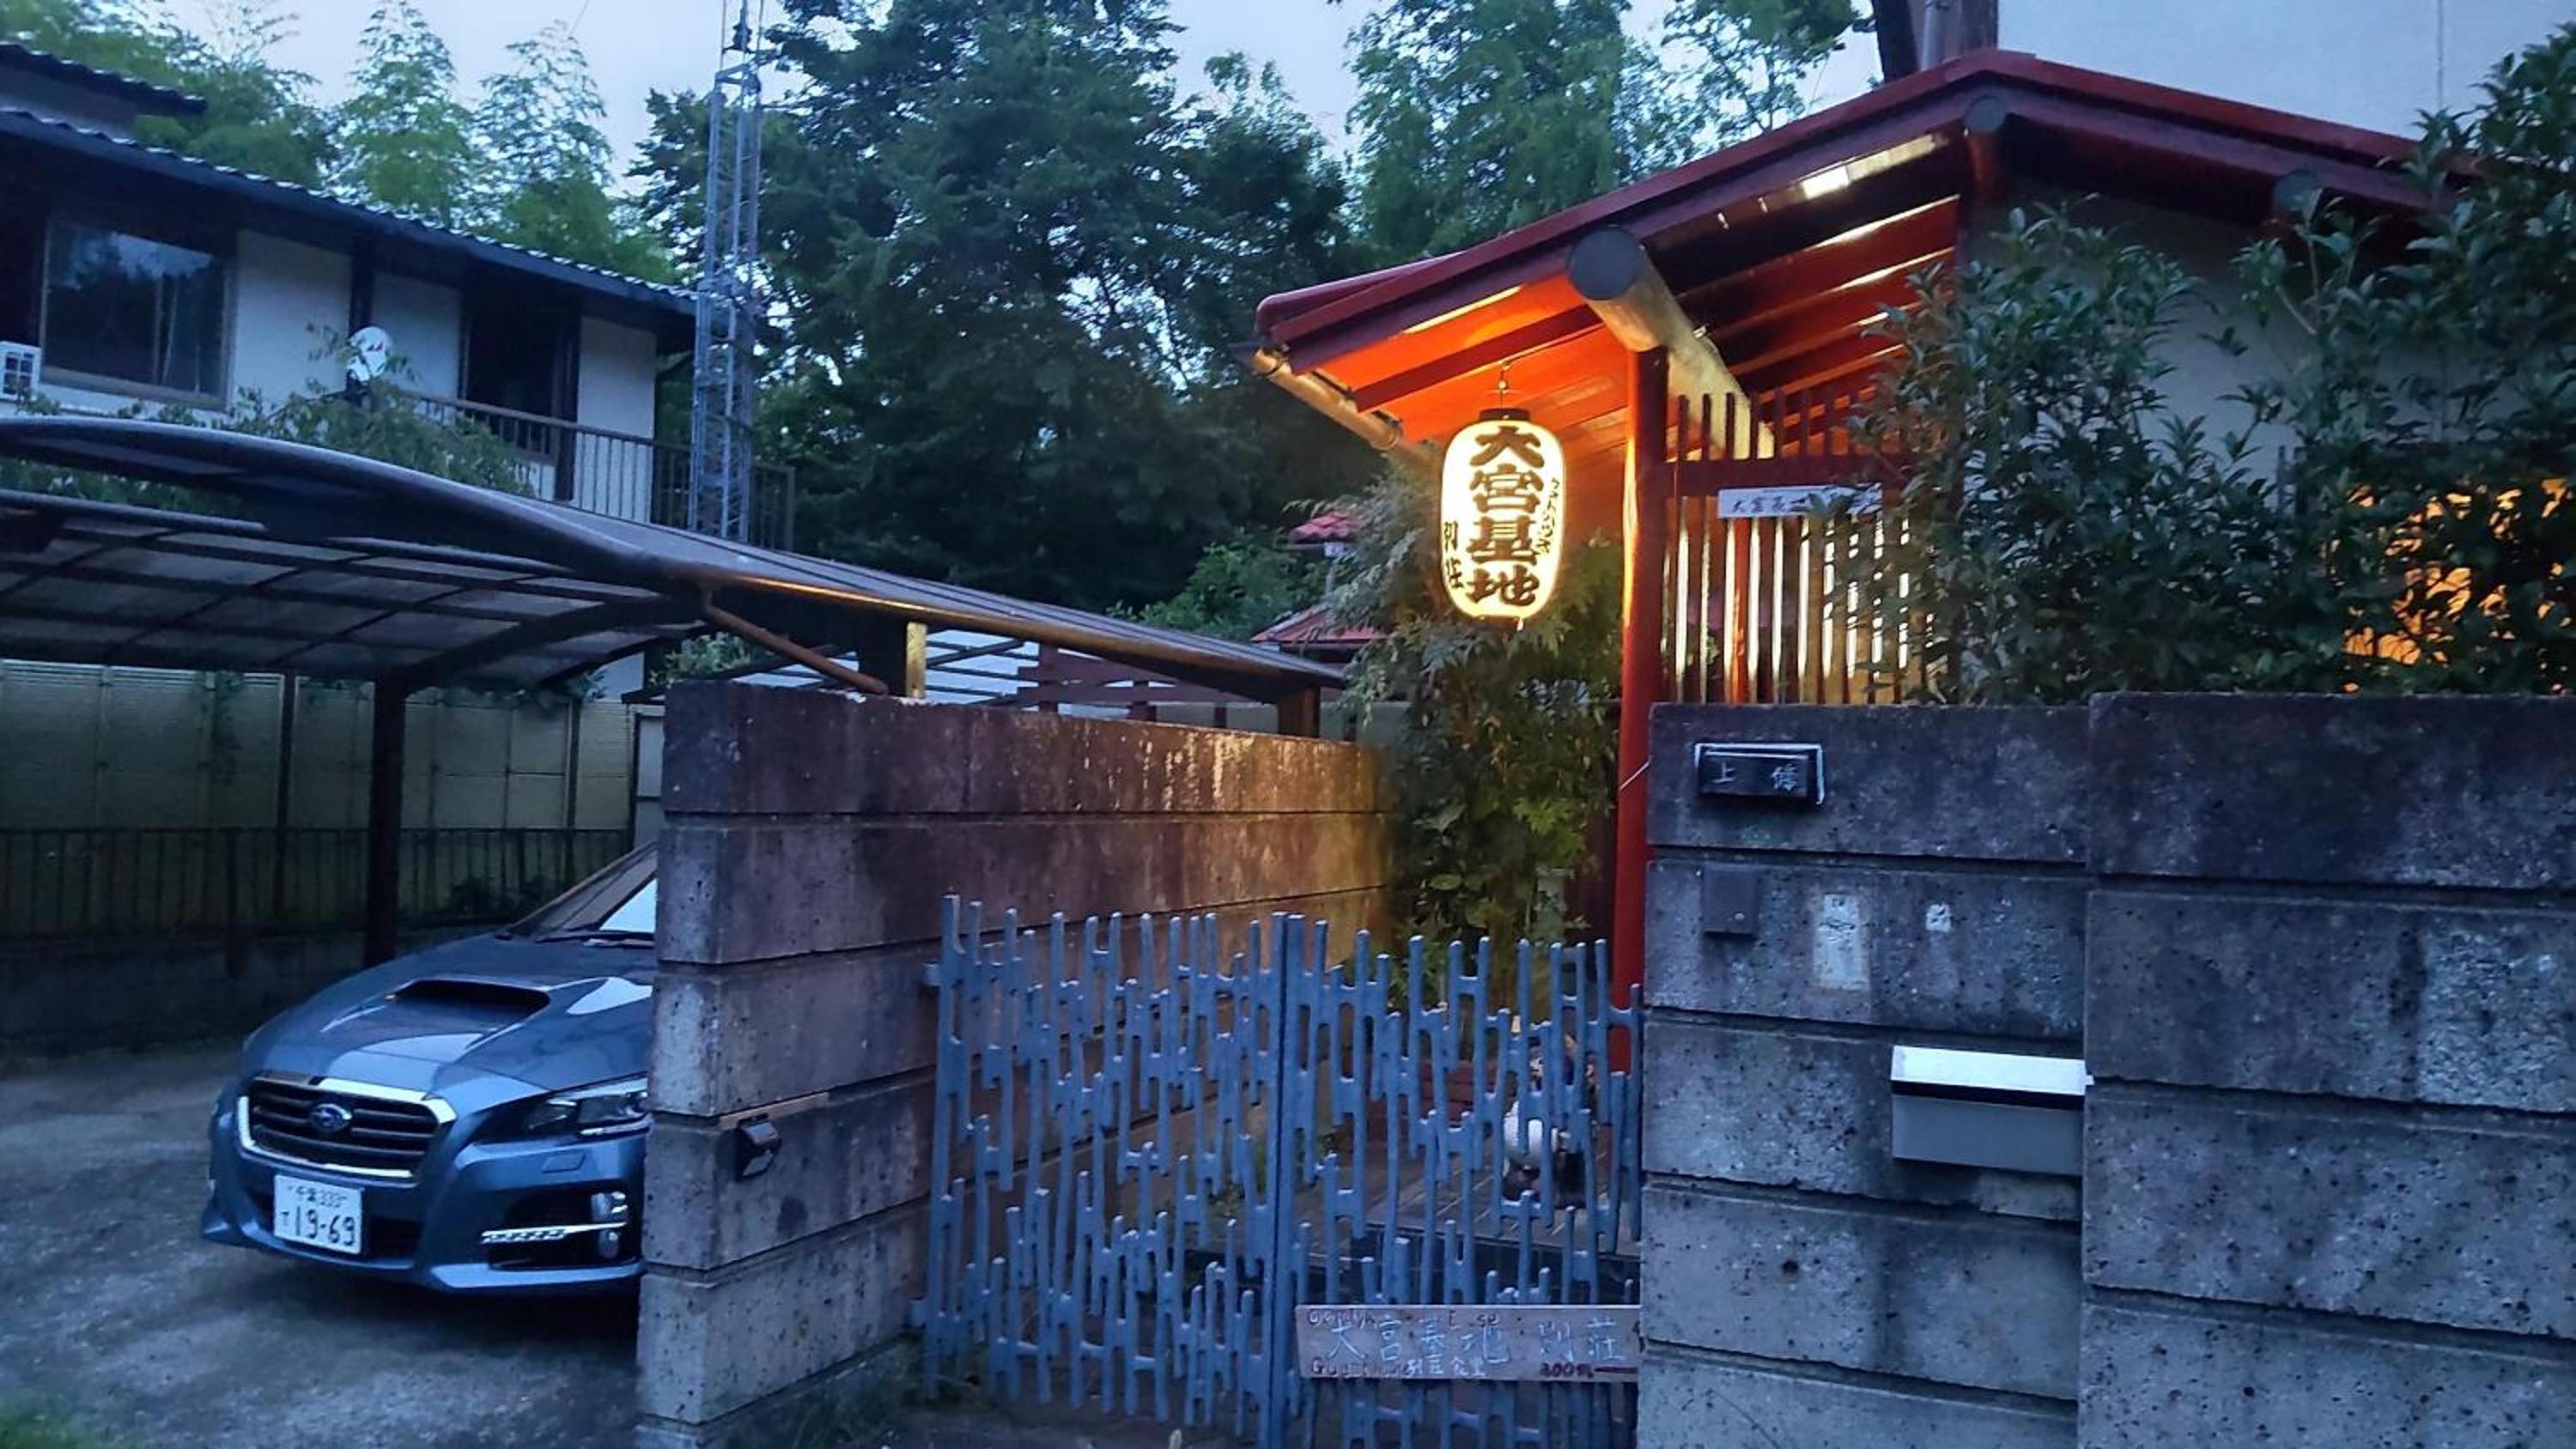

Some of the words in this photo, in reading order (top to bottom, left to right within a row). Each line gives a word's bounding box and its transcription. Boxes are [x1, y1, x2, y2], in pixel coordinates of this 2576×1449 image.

[1467, 426, 1544, 606] 大宮基地
[295, 1205, 355, 1246] 19-69
